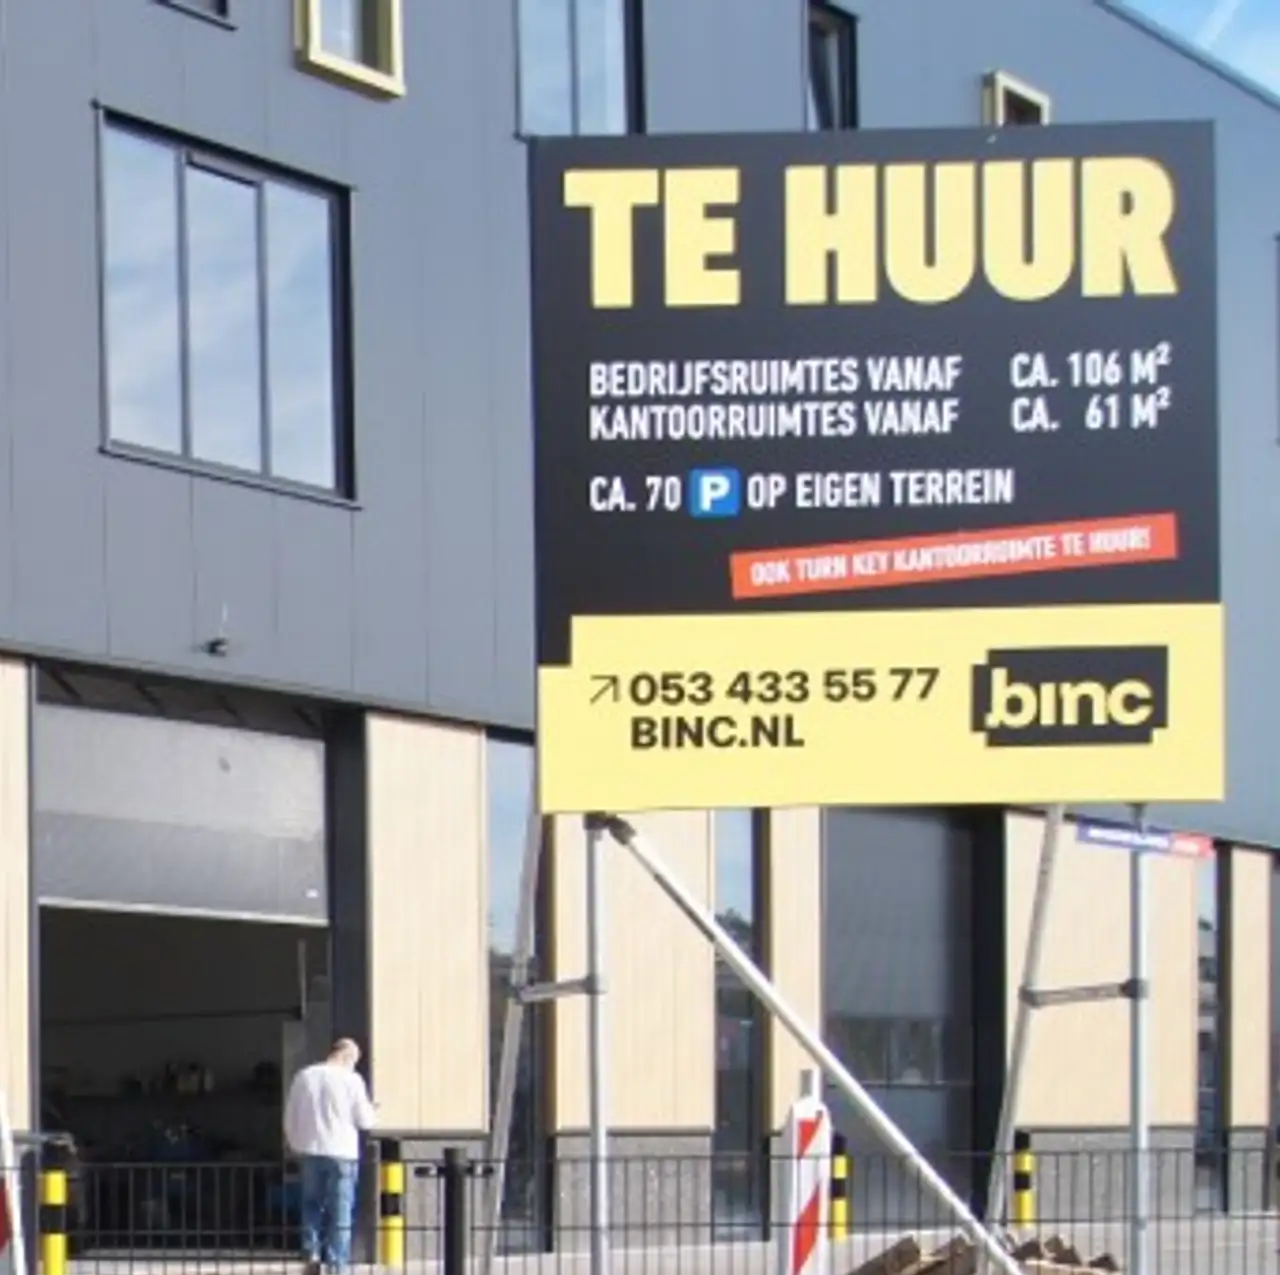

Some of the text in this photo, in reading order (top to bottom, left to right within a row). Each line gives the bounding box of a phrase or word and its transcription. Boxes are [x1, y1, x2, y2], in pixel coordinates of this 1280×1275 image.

[564, 157, 1178, 308] TE HUUR
[589, 357, 858, 397] BEDRIJFSRUIMTES
[867, 356, 962, 393] VANAF
[1011, 352, 1057, 390] CA.
[1067, 349, 1122, 388] 106
[589, 401, 856, 441] KANTOORRUIMTES
[865, 398, 959, 435] VANAF
[1012, 396, 1058, 433] CA.
[1084, 394, 1120, 431] 61
[589, 468, 1014, 512] CA. 70 P OP EIGEN TERREIN
[751, 560, 790, 585] OOK
[797, 555, 846, 581] TURN
[852, 550, 892, 576] KEY
[1061, 531, 1084, 555] TE
[630, 667, 941, 706] 053 433 55 77
[631, 716, 805, 751] BINC.NL
